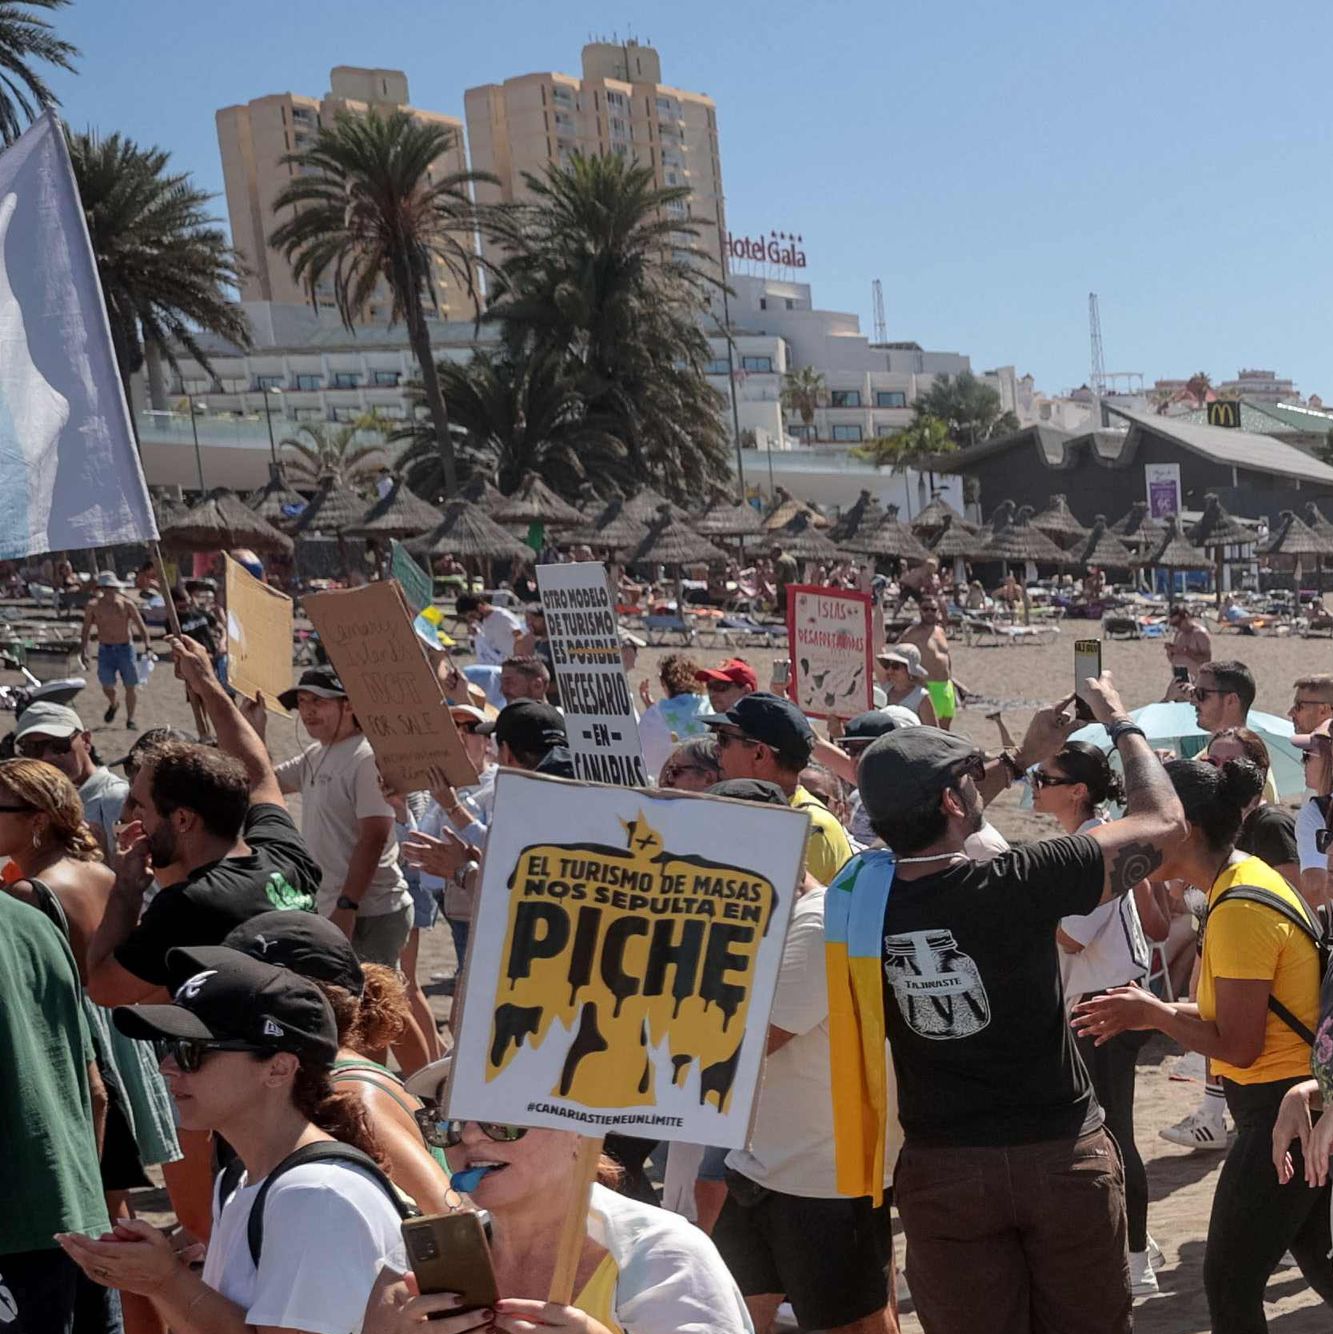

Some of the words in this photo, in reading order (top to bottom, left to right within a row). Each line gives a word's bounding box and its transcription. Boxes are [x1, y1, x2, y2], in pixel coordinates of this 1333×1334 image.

[768, 241, 806, 267] Gala
[543, 589, 566, 609] OTRO
[568, 586, 608, 607] MODELO
[818, 597, 846, 619] ISLAS
[548, 613, 562, 636] DE
[563, 611, 614, 636] TURISMO
[552, 640, 565, 664] ES
[558, 672, 631, 716] NECESARIO
[527, 855, 550, 877] EL
[560, 858, 651, 893] TURISMO
[661, 871, 685, 894] DE
[693, 874, 762, 903] MASAS
[524, 879, 587, 899] NOS
[594, 885, 716, 917] SEPULTA
[722, 902, 762, 922] EN
[507, 901, 756, 1012] PICHE
